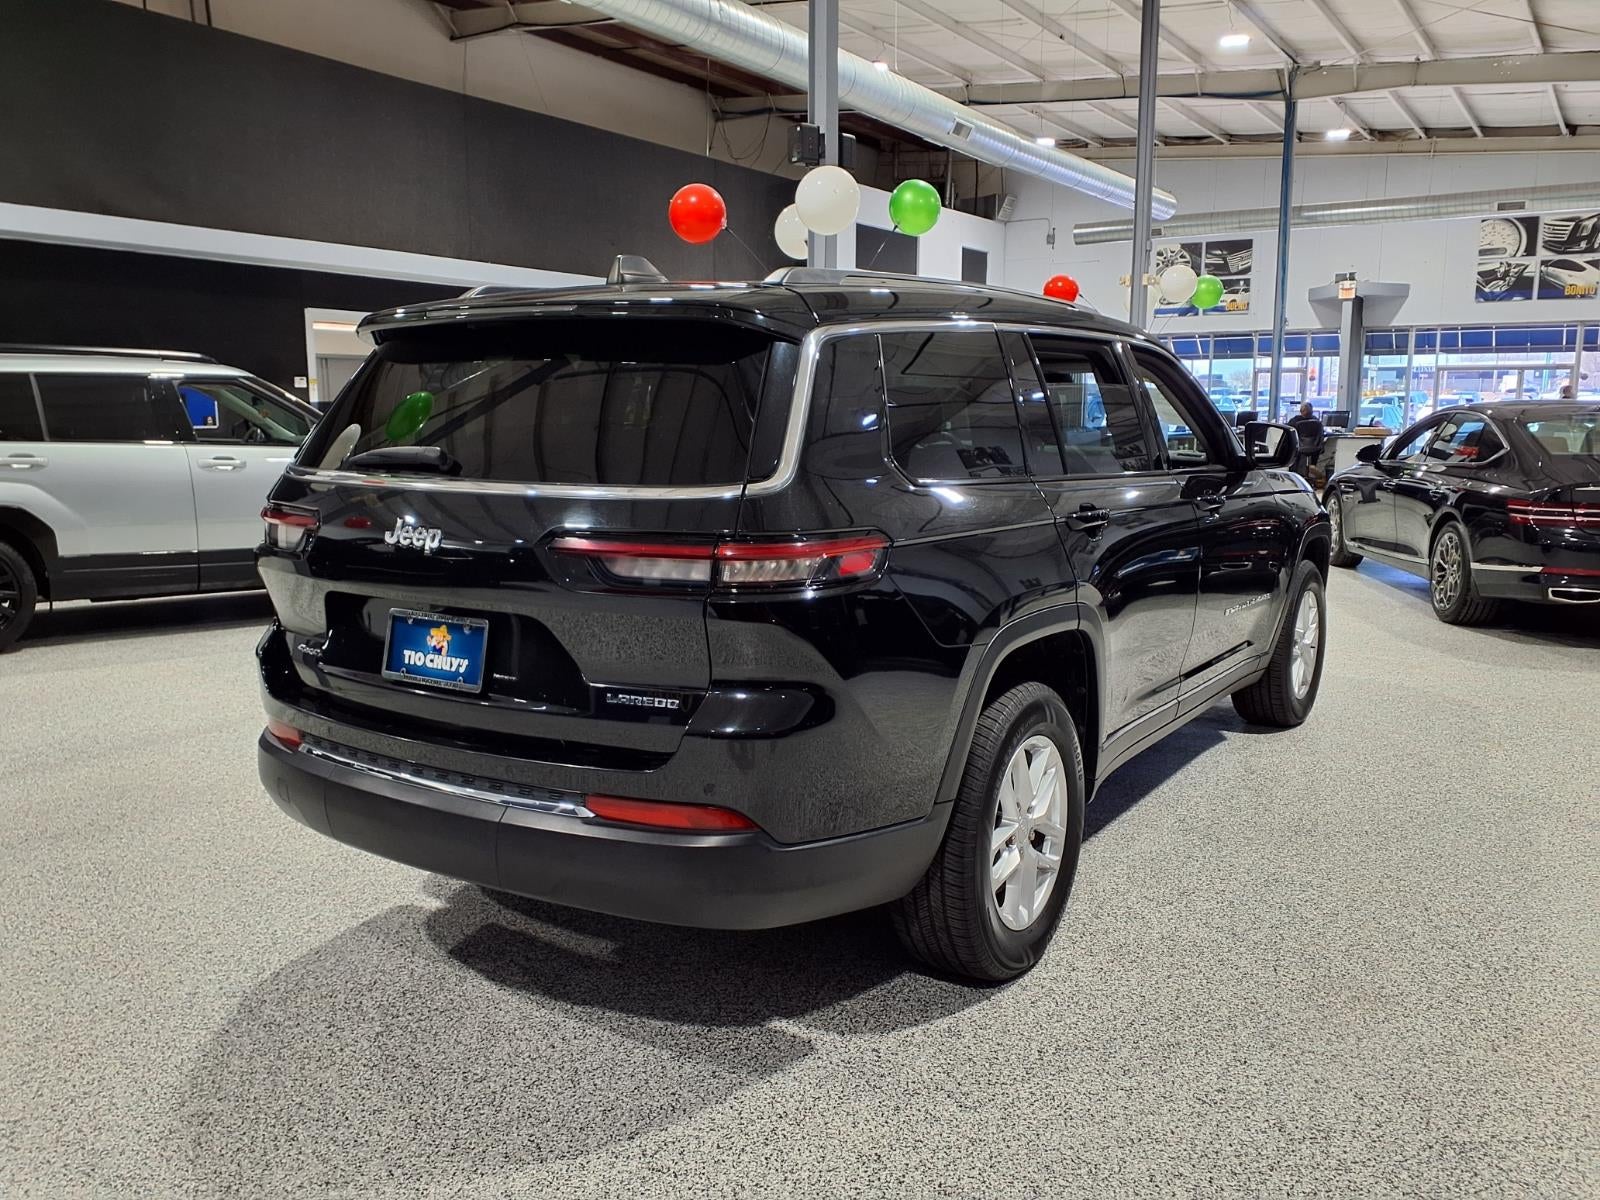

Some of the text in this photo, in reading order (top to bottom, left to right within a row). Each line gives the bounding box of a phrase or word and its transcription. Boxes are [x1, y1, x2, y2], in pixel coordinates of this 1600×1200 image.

[1564, 284, 1597, 296] BONITO
[384, 516, 442, 555] Jeep
[403, 649, 469, 673] TIO CHUY'S
[606, 693, 680, 709] LAREDO
